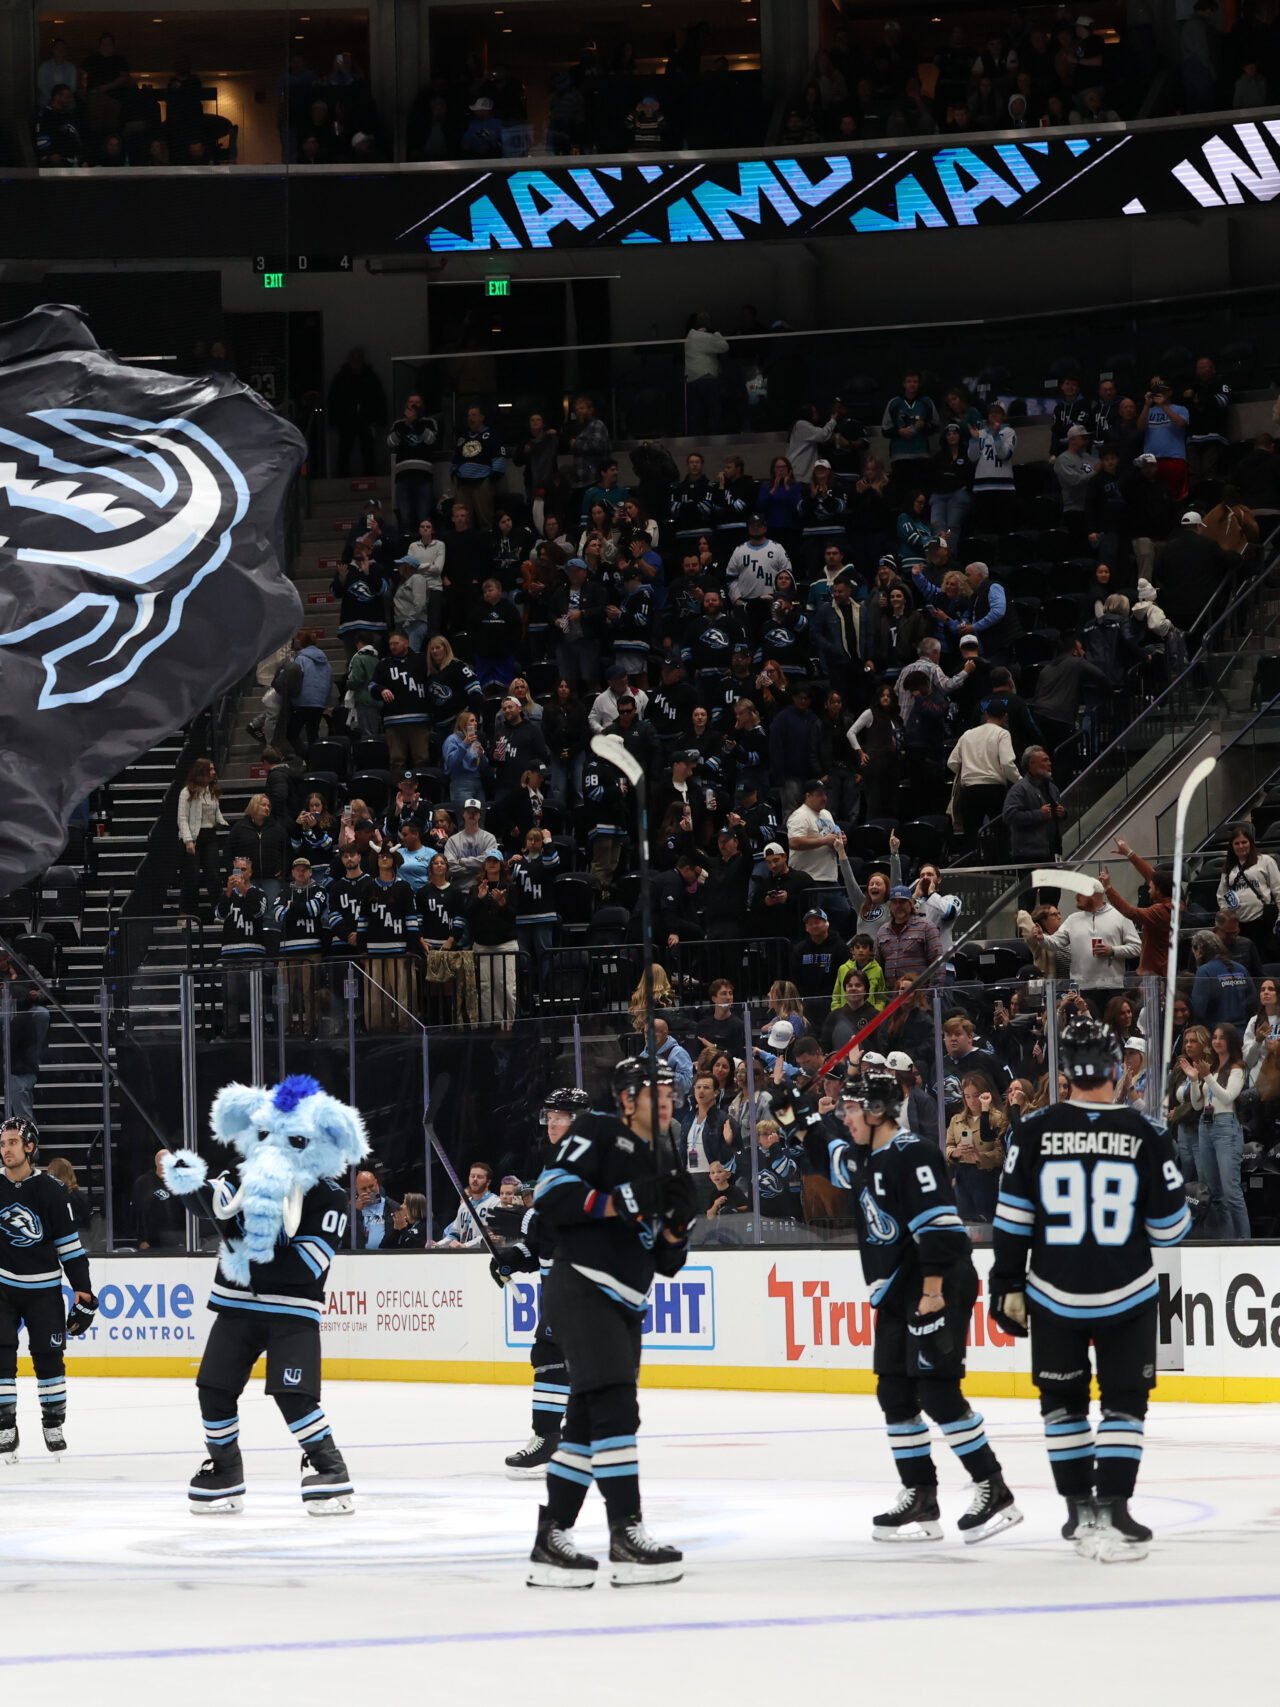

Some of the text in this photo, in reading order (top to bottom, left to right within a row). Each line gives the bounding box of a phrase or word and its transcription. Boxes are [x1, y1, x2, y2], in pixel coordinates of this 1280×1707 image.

[298, 257, 307, 270] D
[340, 256, 349, 269] 4
[264, 274, 283, 288] EXIT
[489, 281, 507, 296] EXIT
[743, 554, 773, 587] UTAH
[389, 666, 426, 700] UTAH
[585, 774, 599, 787] 98
[371, 902, 403, 935] UTAH
[428, 898, 454, 931] UTAH
[1073, 1063, 1095, 1076] 98
[556, 1134, 592, 1162] 17
[1040, 1131, 1143, 1160] SERGACHEV
[874, 1172, 886, 1196] C
[915, 1165, 938, 1193] 9
[1039, 1160, 1140, 1246] 98
[62, 1284, 195, 1319] oxie
[318, 1291, 367, 1315] EALTH
[376, 1289, 464, 1308] OFFICIAL CARE
[109, 1326, 195, 1341] CONTROL
[343, 1322, 351, 1332] OF
[352, 1322, 368, 1332] UTAH
[377, 1314, 436, 1332] PROVIDER
[1039, 1369, 1084, 1381] BAUER
